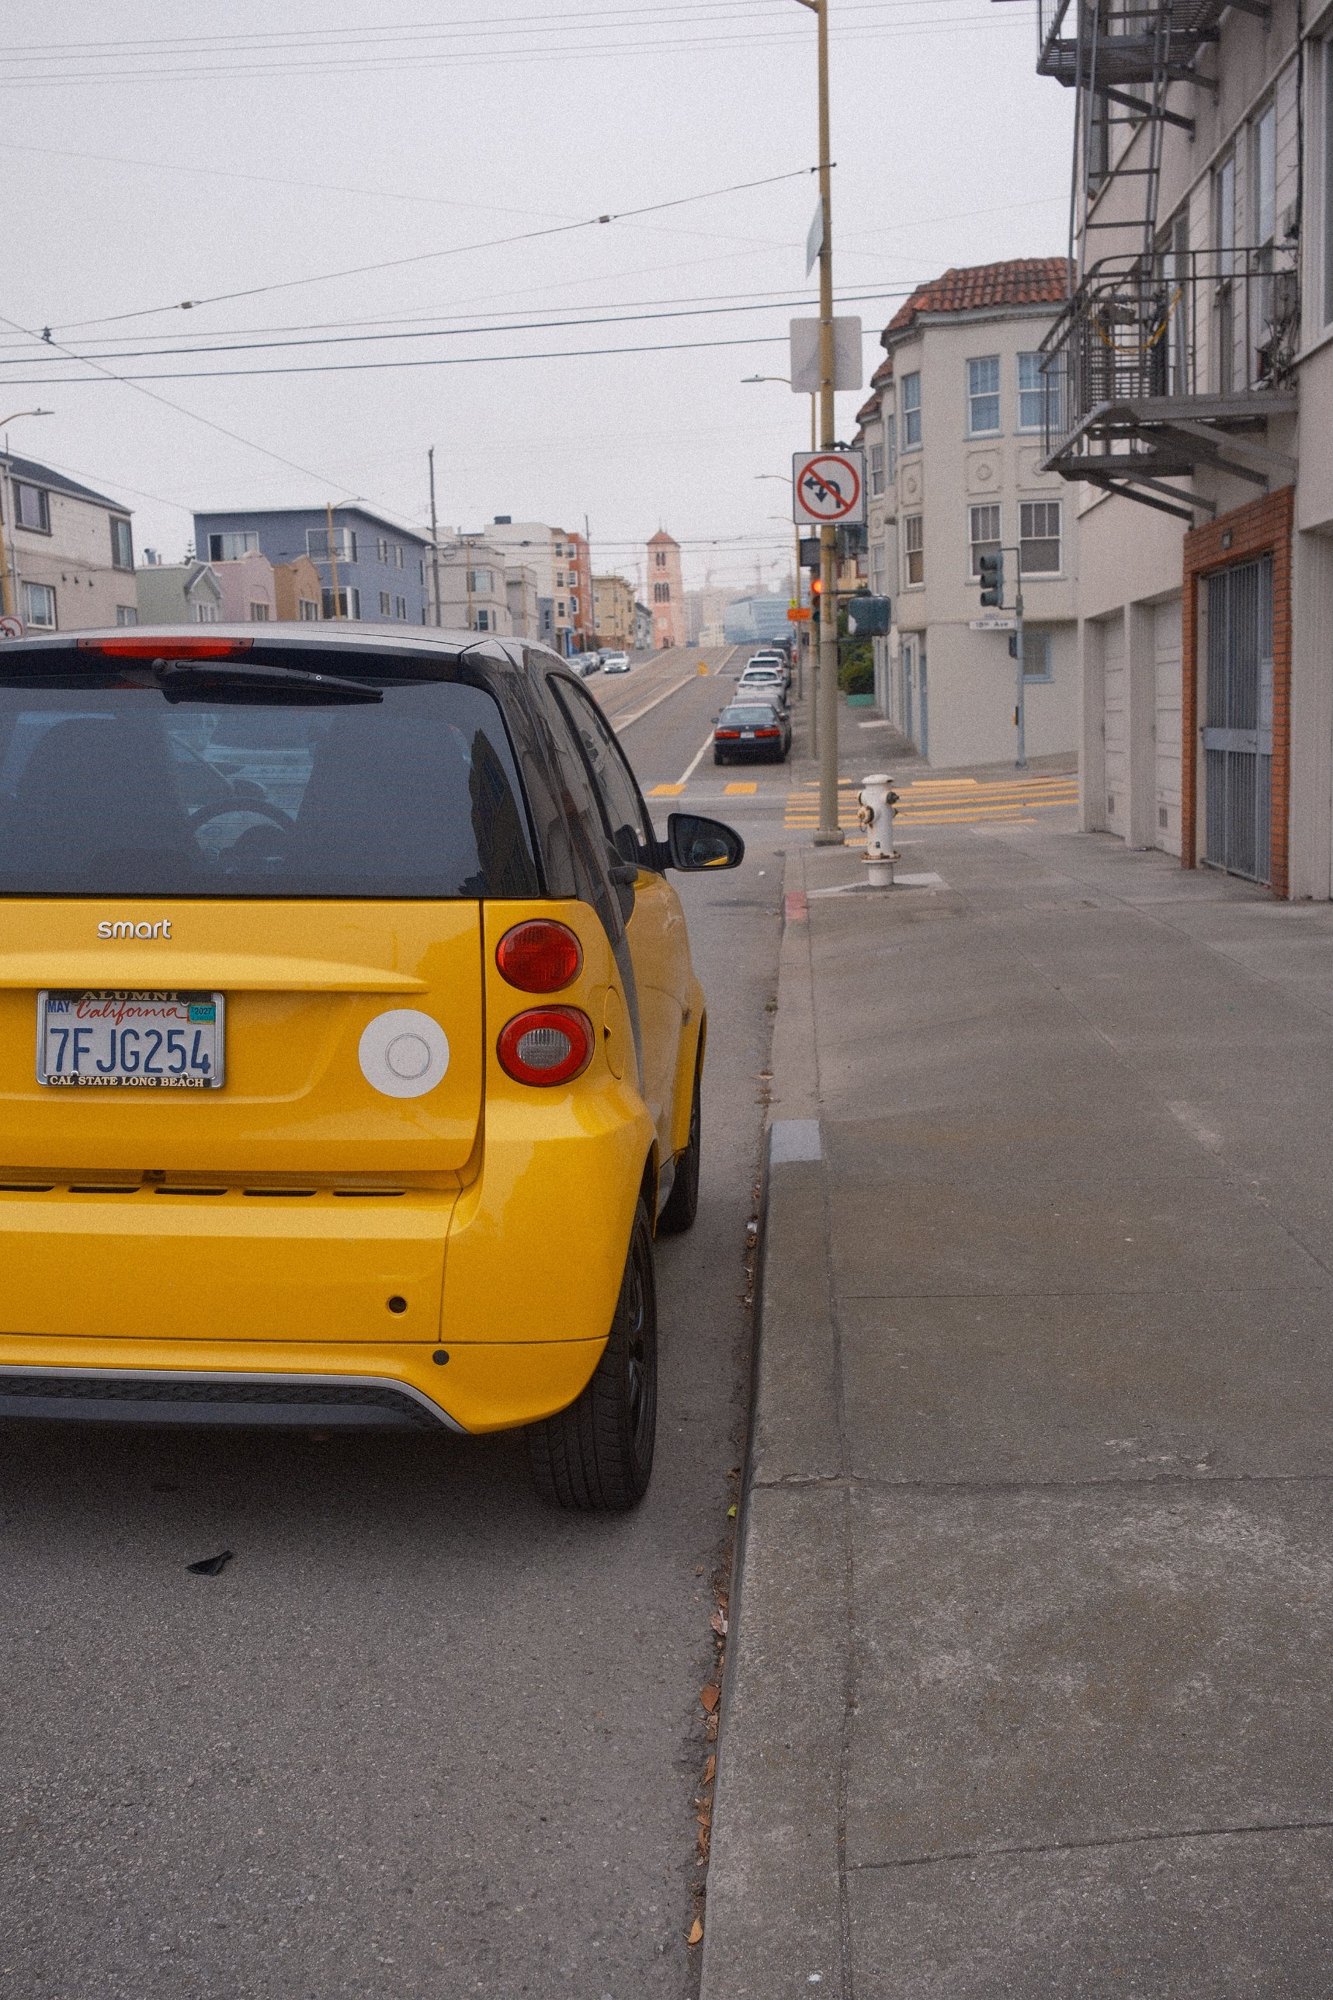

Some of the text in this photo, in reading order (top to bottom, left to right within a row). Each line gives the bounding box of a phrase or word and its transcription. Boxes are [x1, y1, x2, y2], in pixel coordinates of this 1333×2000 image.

[97, 919, 172, 939] smart
[81, 991, 178, 1000] ALUMNI
[48, 1000, 70, 1012] MAY
[194, 1007, 212, 1015] 2027
[76, 1000, 187, 1026] California
[50, 1028, 211, 1074] 7FJG254
[50, 1076, 204, 1088] CAL STATE LONG BEACH
